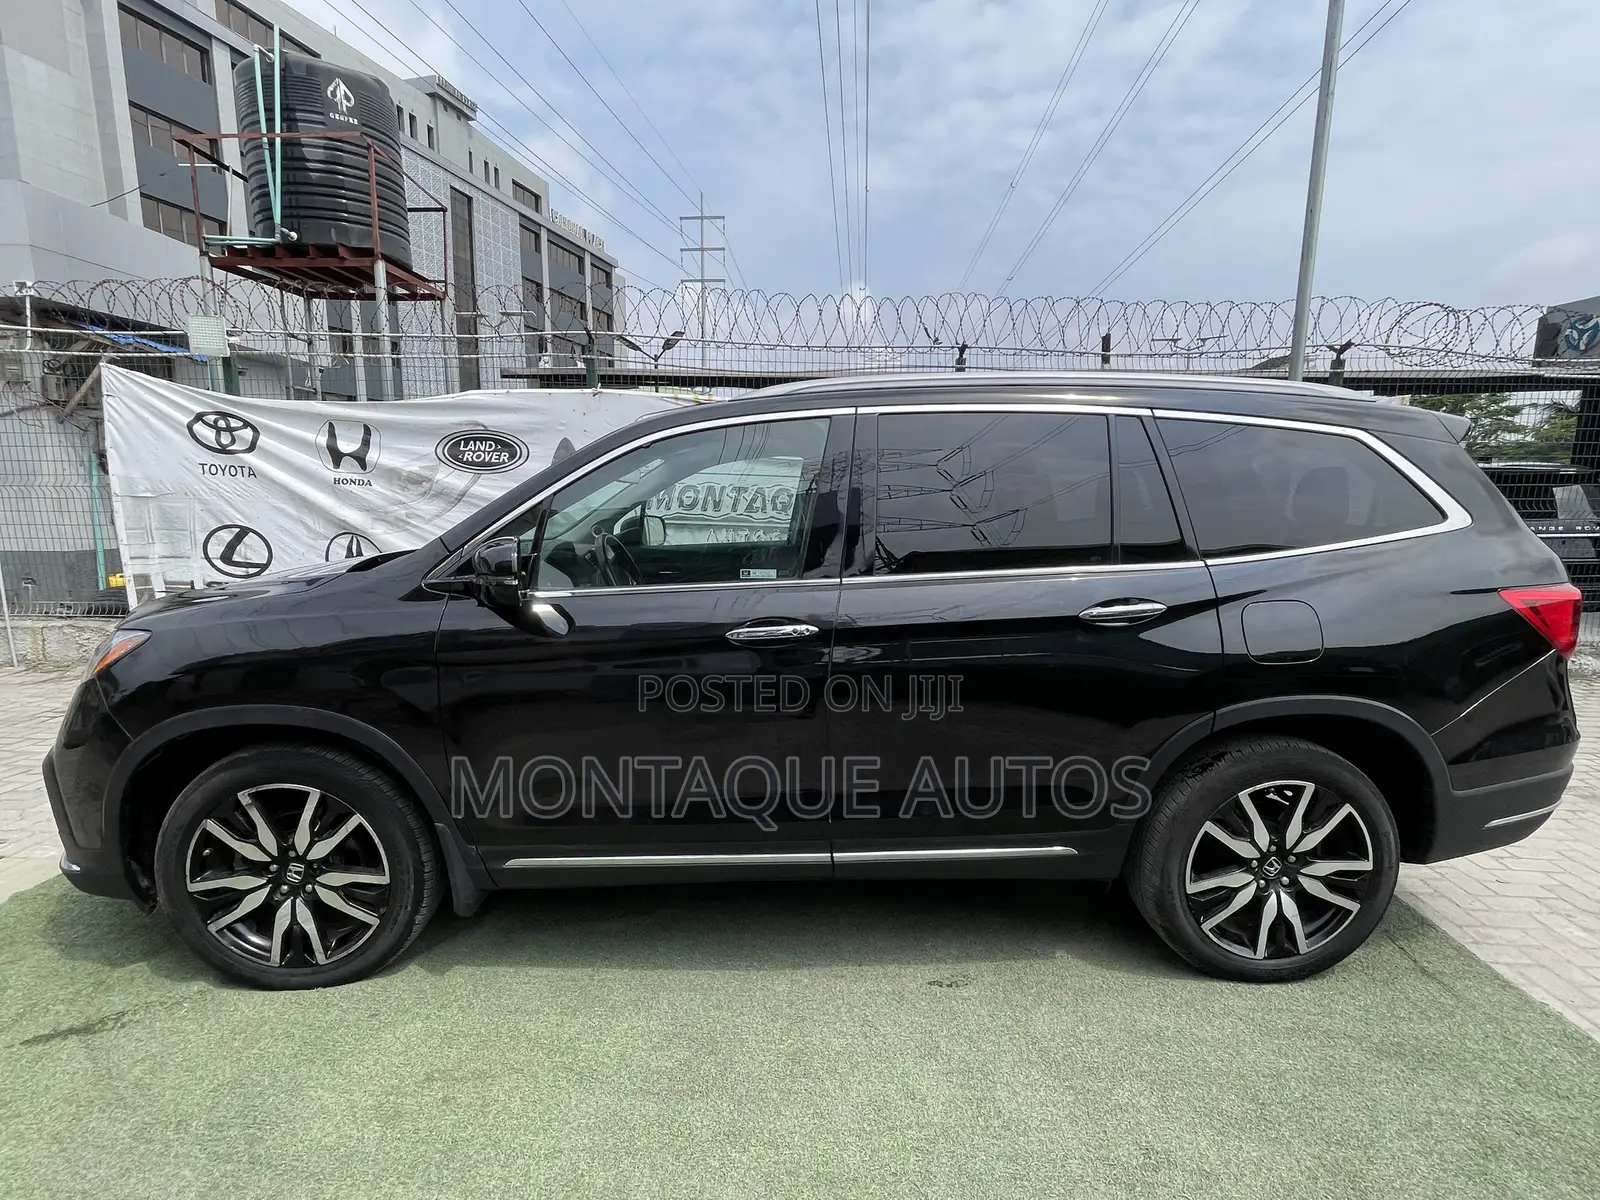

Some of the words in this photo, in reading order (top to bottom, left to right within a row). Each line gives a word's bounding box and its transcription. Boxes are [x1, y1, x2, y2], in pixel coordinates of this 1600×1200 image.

[459, 440, 496, 451] LAND
[463, 451, 510, 463] ROVER
[198, 462, 258, 479] TOYOTA
[332, 477, 373, 487] HONDA
